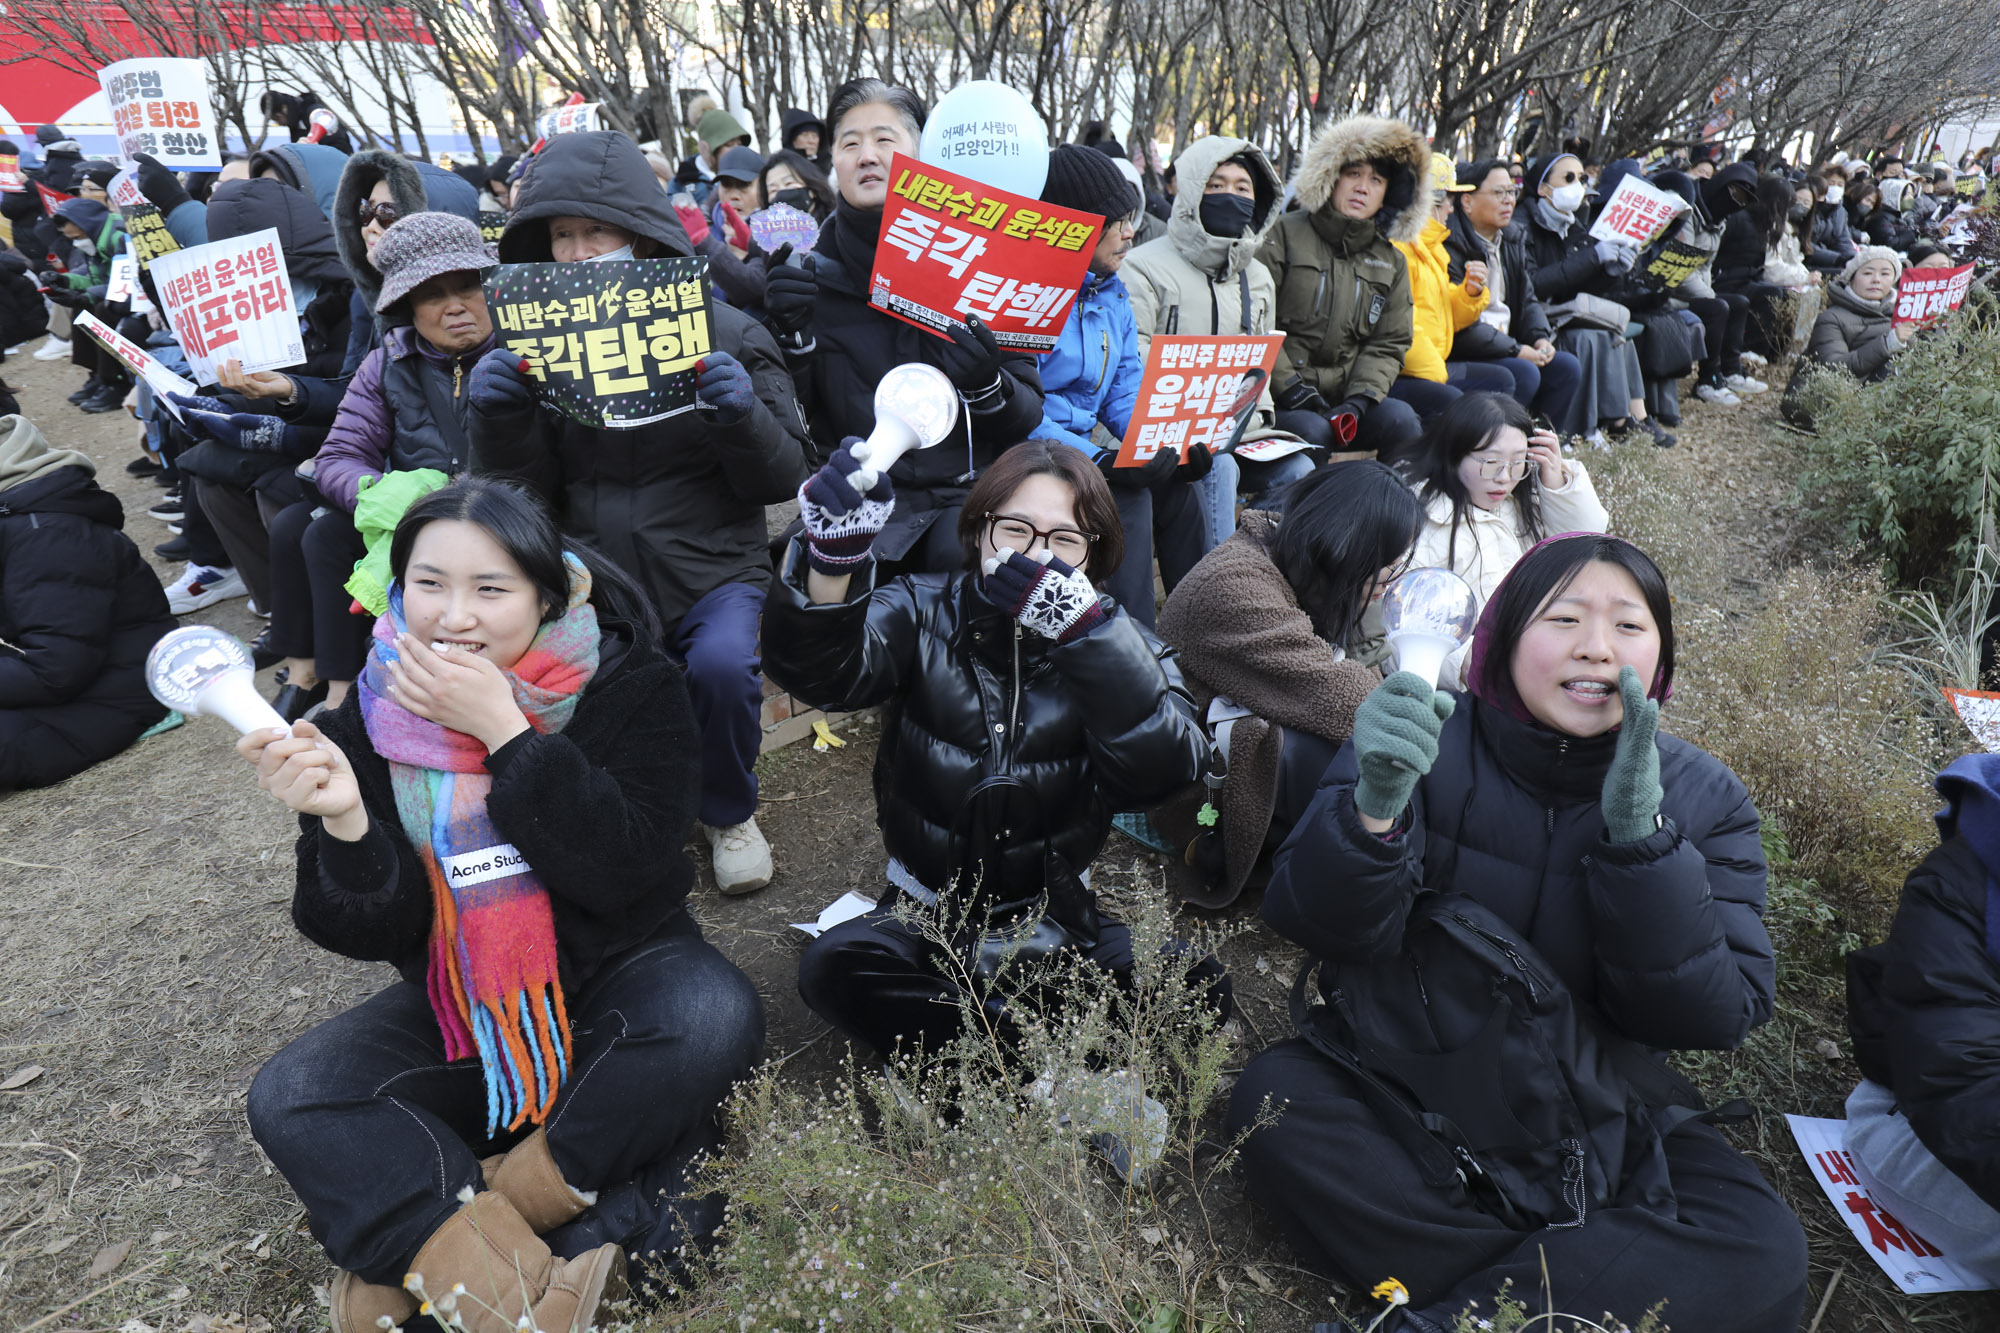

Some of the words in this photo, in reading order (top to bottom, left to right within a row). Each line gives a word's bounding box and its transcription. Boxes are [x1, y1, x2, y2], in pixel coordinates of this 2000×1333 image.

[146, 101, 201, 128] 퇴진
[162, 132, 208, 156] 청산
[942, 121, 977, 140] 어째서
[981, 121, 1018, 137] 사람이
[941, 144, 951, 160] 이
[954, 139, 1008, 156] 모양인가
[892, 169, 1009, 230] 내란수괴
[1002, 208, 1095, 251] 윤석열
[1618, 189, 1659, 215] 내란범
[884, 208, 989, 280] 즉각
[163, 265, 212, 309] 내란범
[214, 242, 279, 289] 윤석열
[1902, 280, 1948, 292] 내란동조
[496, 294, 598, 331] 내란수괴
[625, 278, 705, 318] 윤석열
[894, 296, 914, 311] 윤석열
[915, 304, 929, 317] 즉각
[930, 311, 947, 324] 탄핵!
[953, 271, 1077, 328] 탄핵!
[174, 275, 287, 359] 체포하라
[1160, 343, 1217, 368] 반민주
[1216, 343, 1268, 367] 반헌법
[1147, 373, 1245, 417] 윤석열
[1133, 419, 1191, 460] 탄핵
[452, 862, 491, 879] Acne
